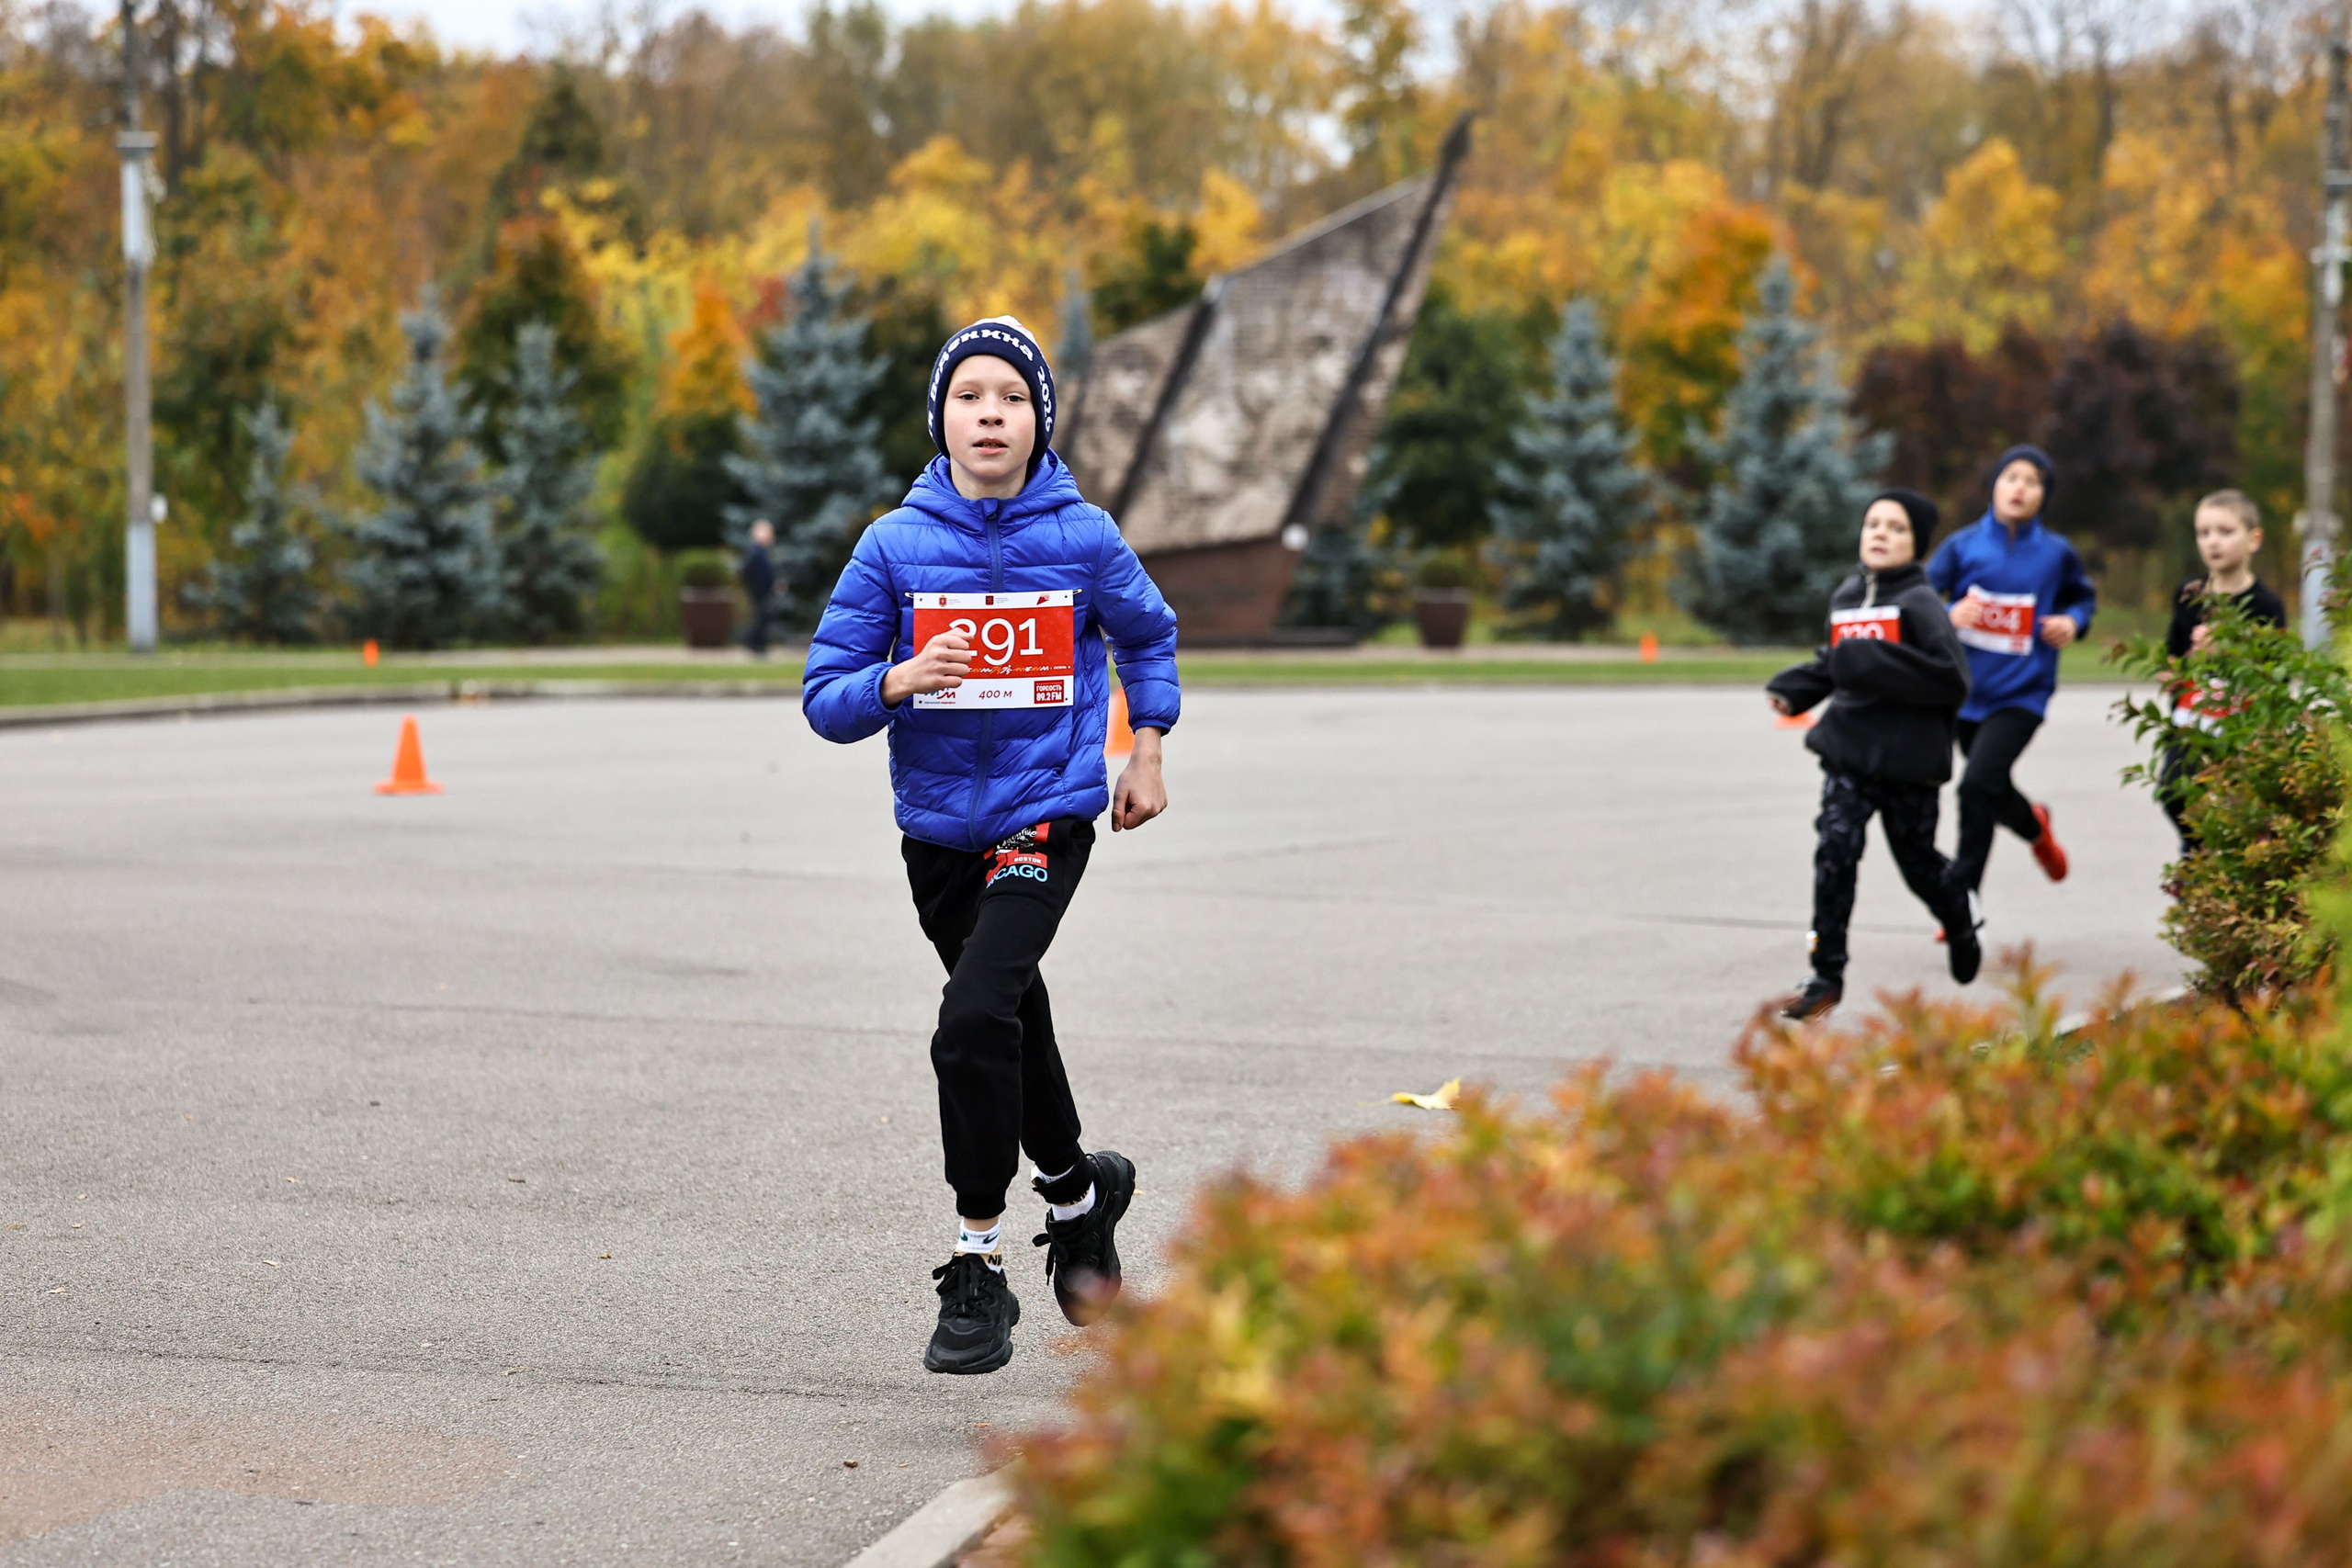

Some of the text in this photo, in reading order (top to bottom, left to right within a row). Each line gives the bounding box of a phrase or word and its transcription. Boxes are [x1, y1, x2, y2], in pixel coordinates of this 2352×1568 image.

[1036, 366, 1054, 433] 2026
[1036, 684, 1062, 693] ГОРДОСТЬ
[978, 689, 1001, 700] 400
[1035, 692, 1062, 702] 89.2 FM
[1013, 856, 1042, 864] BOSTON
